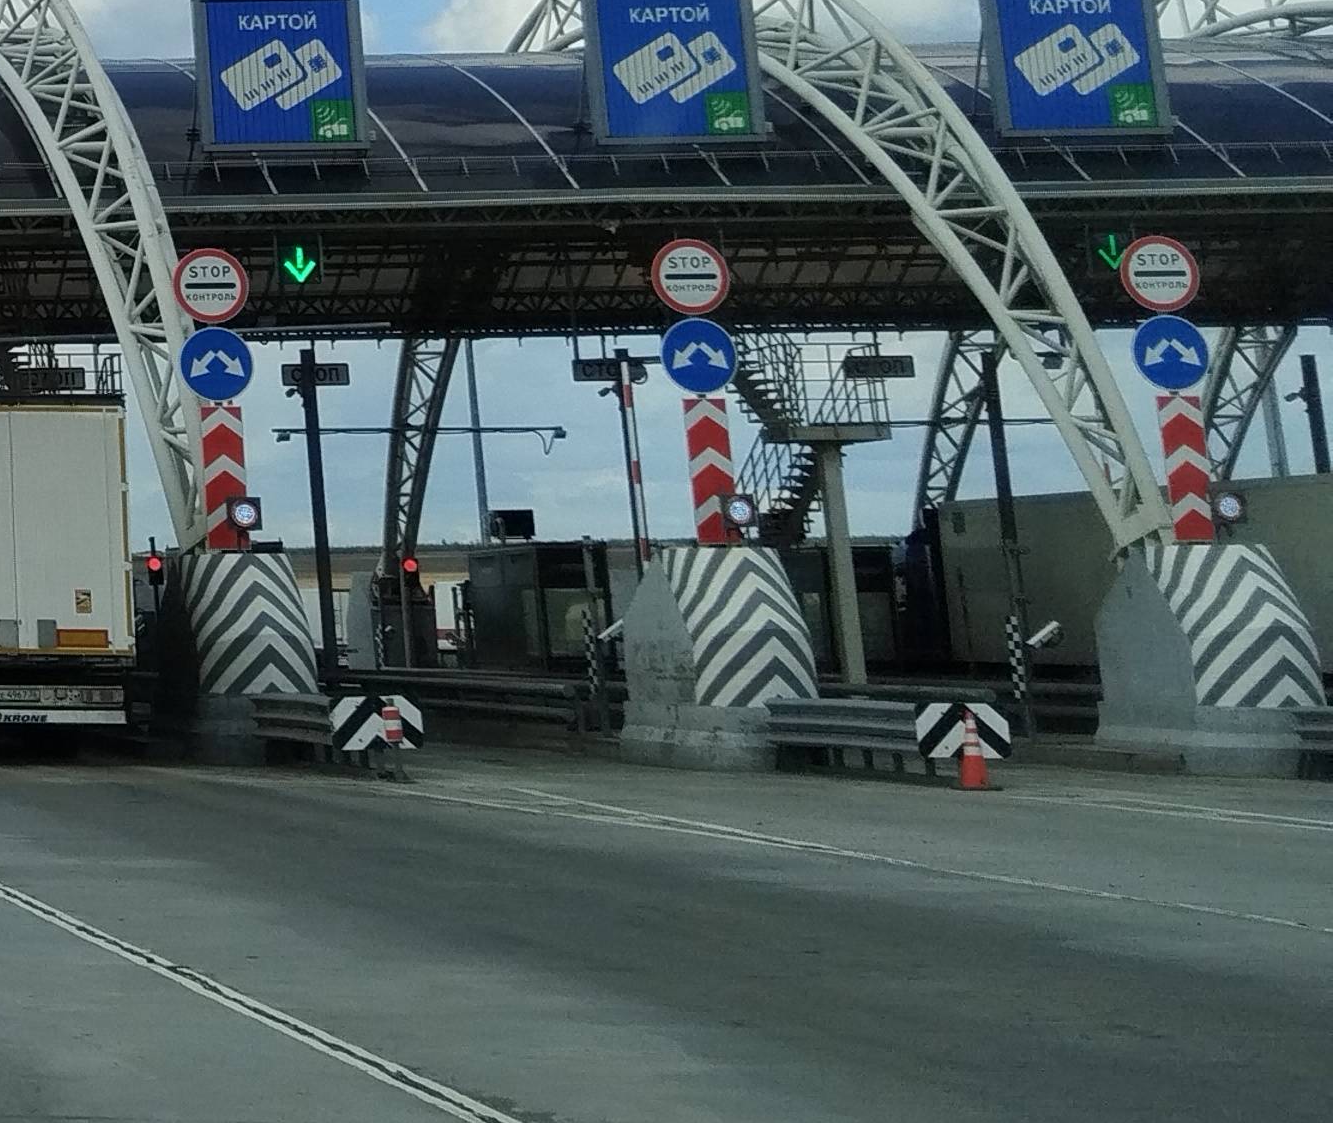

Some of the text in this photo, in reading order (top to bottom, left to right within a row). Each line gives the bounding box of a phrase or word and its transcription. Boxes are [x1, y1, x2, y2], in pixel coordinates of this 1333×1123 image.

[629, 3, 710, 23] КАРТОЙ
[238, 10, 317, 31] КАРТОЙ
[668, 257, 711, 268] STOP
[1137, 254, 1180, 266] STOP
[189, 266, 231, 278] STOP
[666, 284, 718, 292] КОНТРОЛЬ
[1135, 281, 1188, 289] КОНТРОЛЬ
[186, 293, 236, 301] КОНТРОЛЬ
[291, 367, 339, 382] СОП
[4, 714, 47, 722] KRONE
